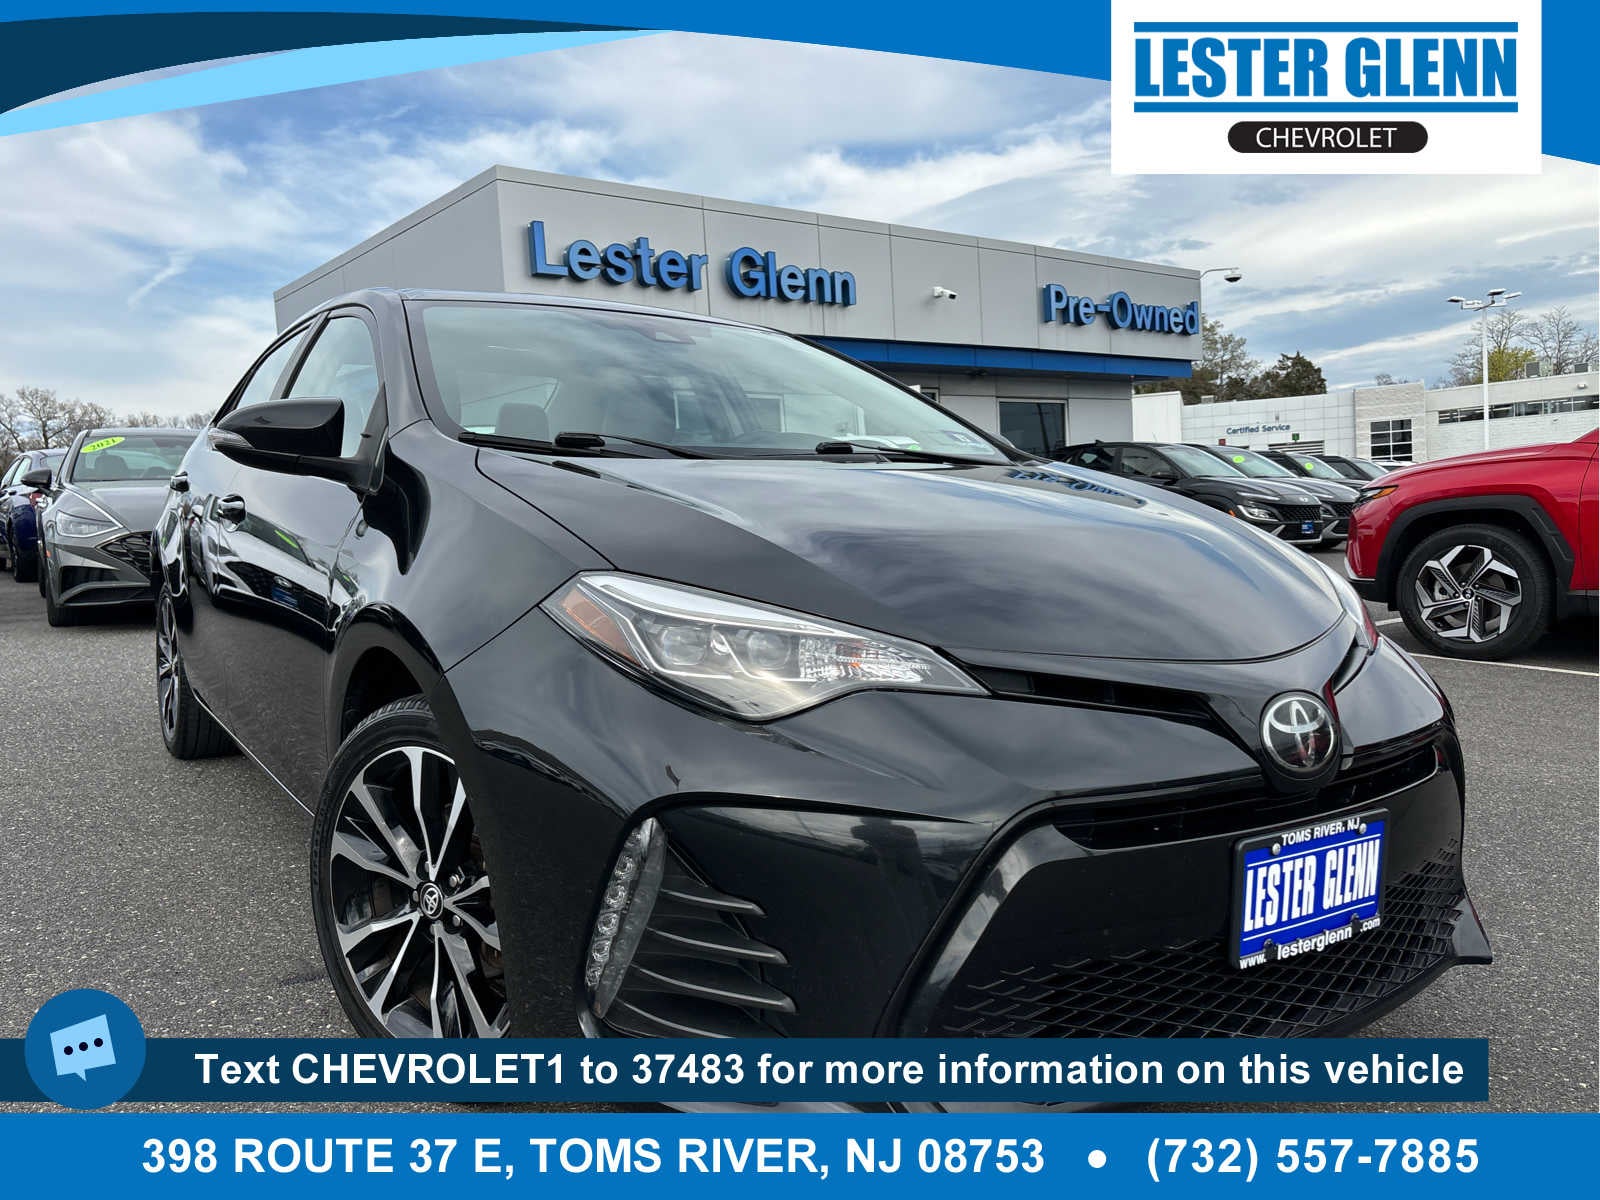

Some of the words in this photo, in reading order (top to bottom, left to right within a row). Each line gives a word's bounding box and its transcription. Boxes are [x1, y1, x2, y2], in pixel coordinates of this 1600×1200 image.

[528, 220, 708, 291] Lester
[727, 246, 857, 306] Glenn
[1043, 283, 1200, 335] Pre-Owned
[1226, 425, 1260, 434] Certified
[1262, 424, 1291, 432] Service
[1281, 830, 1312, 847] TOMS
[1346, 817, 1361, 831] NJ
[1243, 854, 1317, 933] LESTER
[1322, 838, 1381, 910] GLENN
[1277, 926, 1353, 961] lesterglenn
